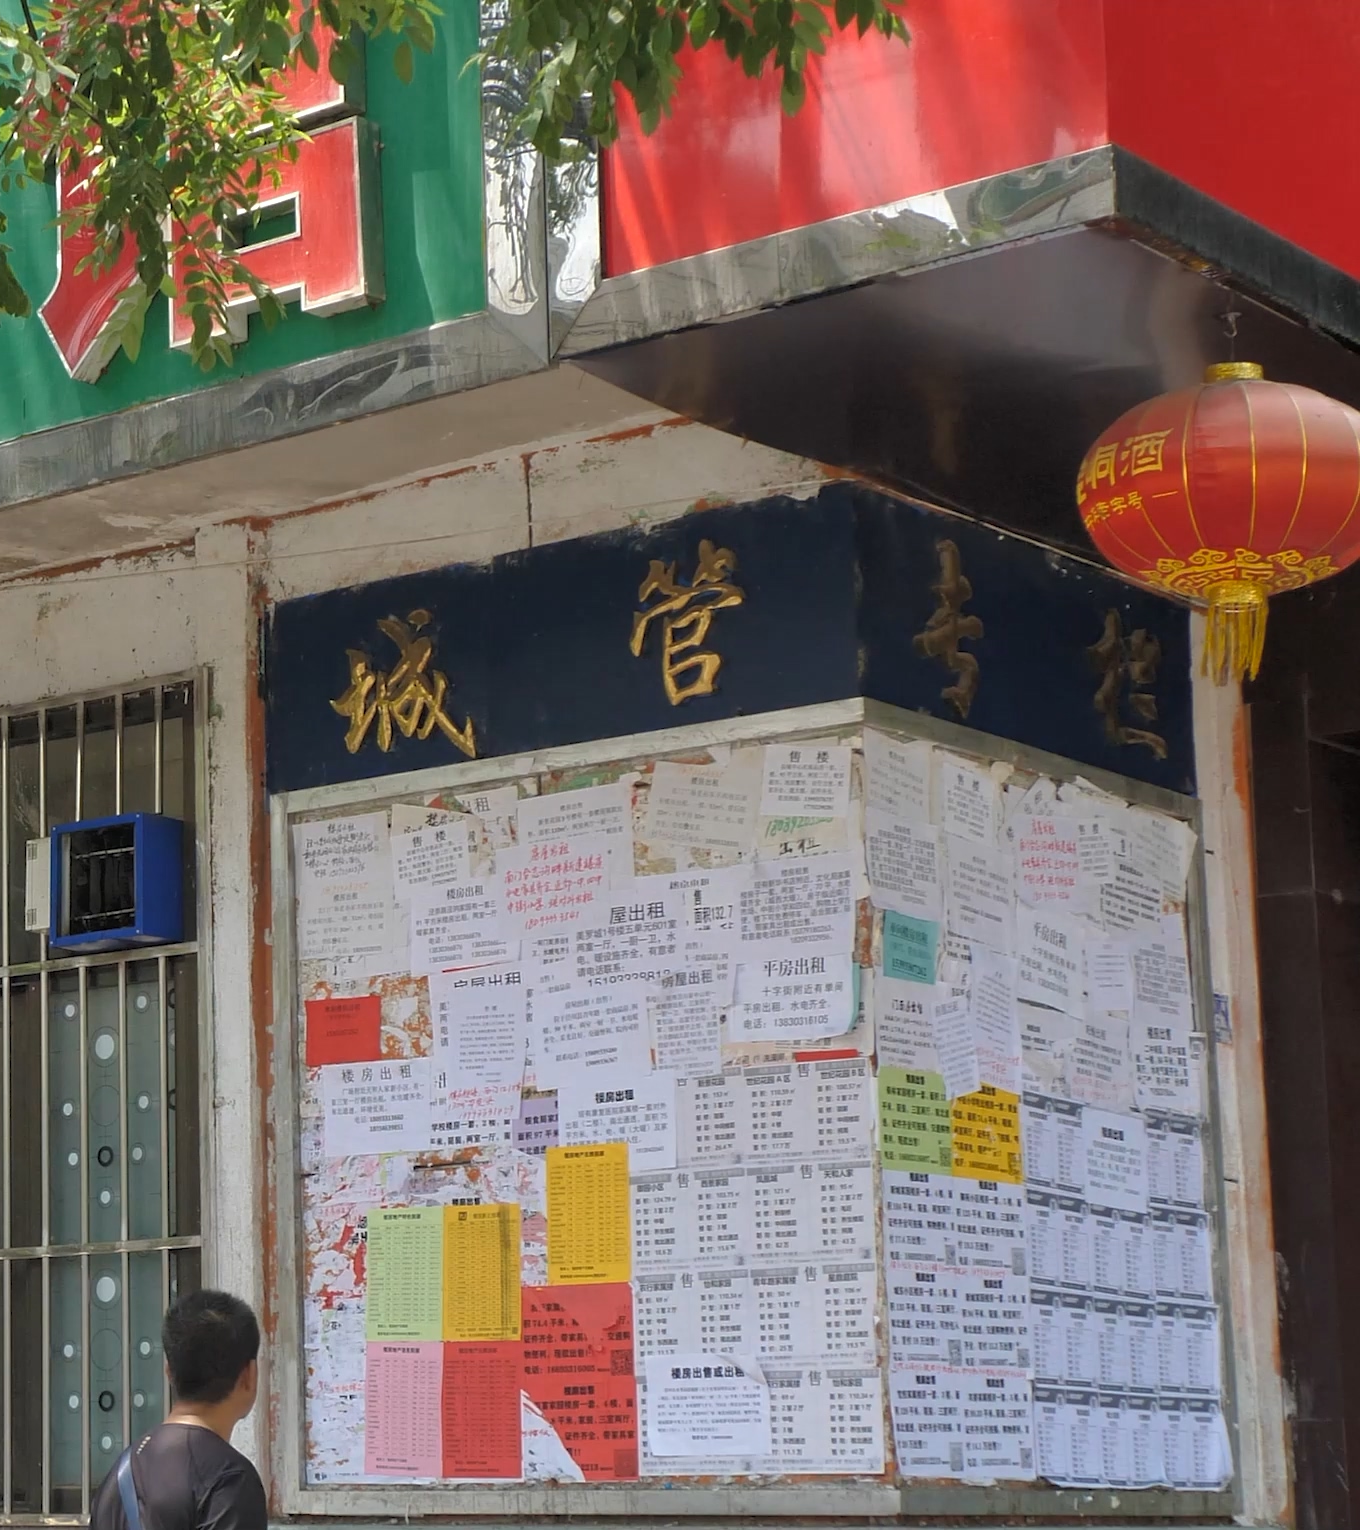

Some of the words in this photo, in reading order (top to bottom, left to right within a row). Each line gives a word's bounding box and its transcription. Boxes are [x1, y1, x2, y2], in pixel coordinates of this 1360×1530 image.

[764, 956, 826, 978] 平房出租
[761, 981, 844, 997] 十字街附近有单间
[341, 1064, 412, 1083] 楼房出租
